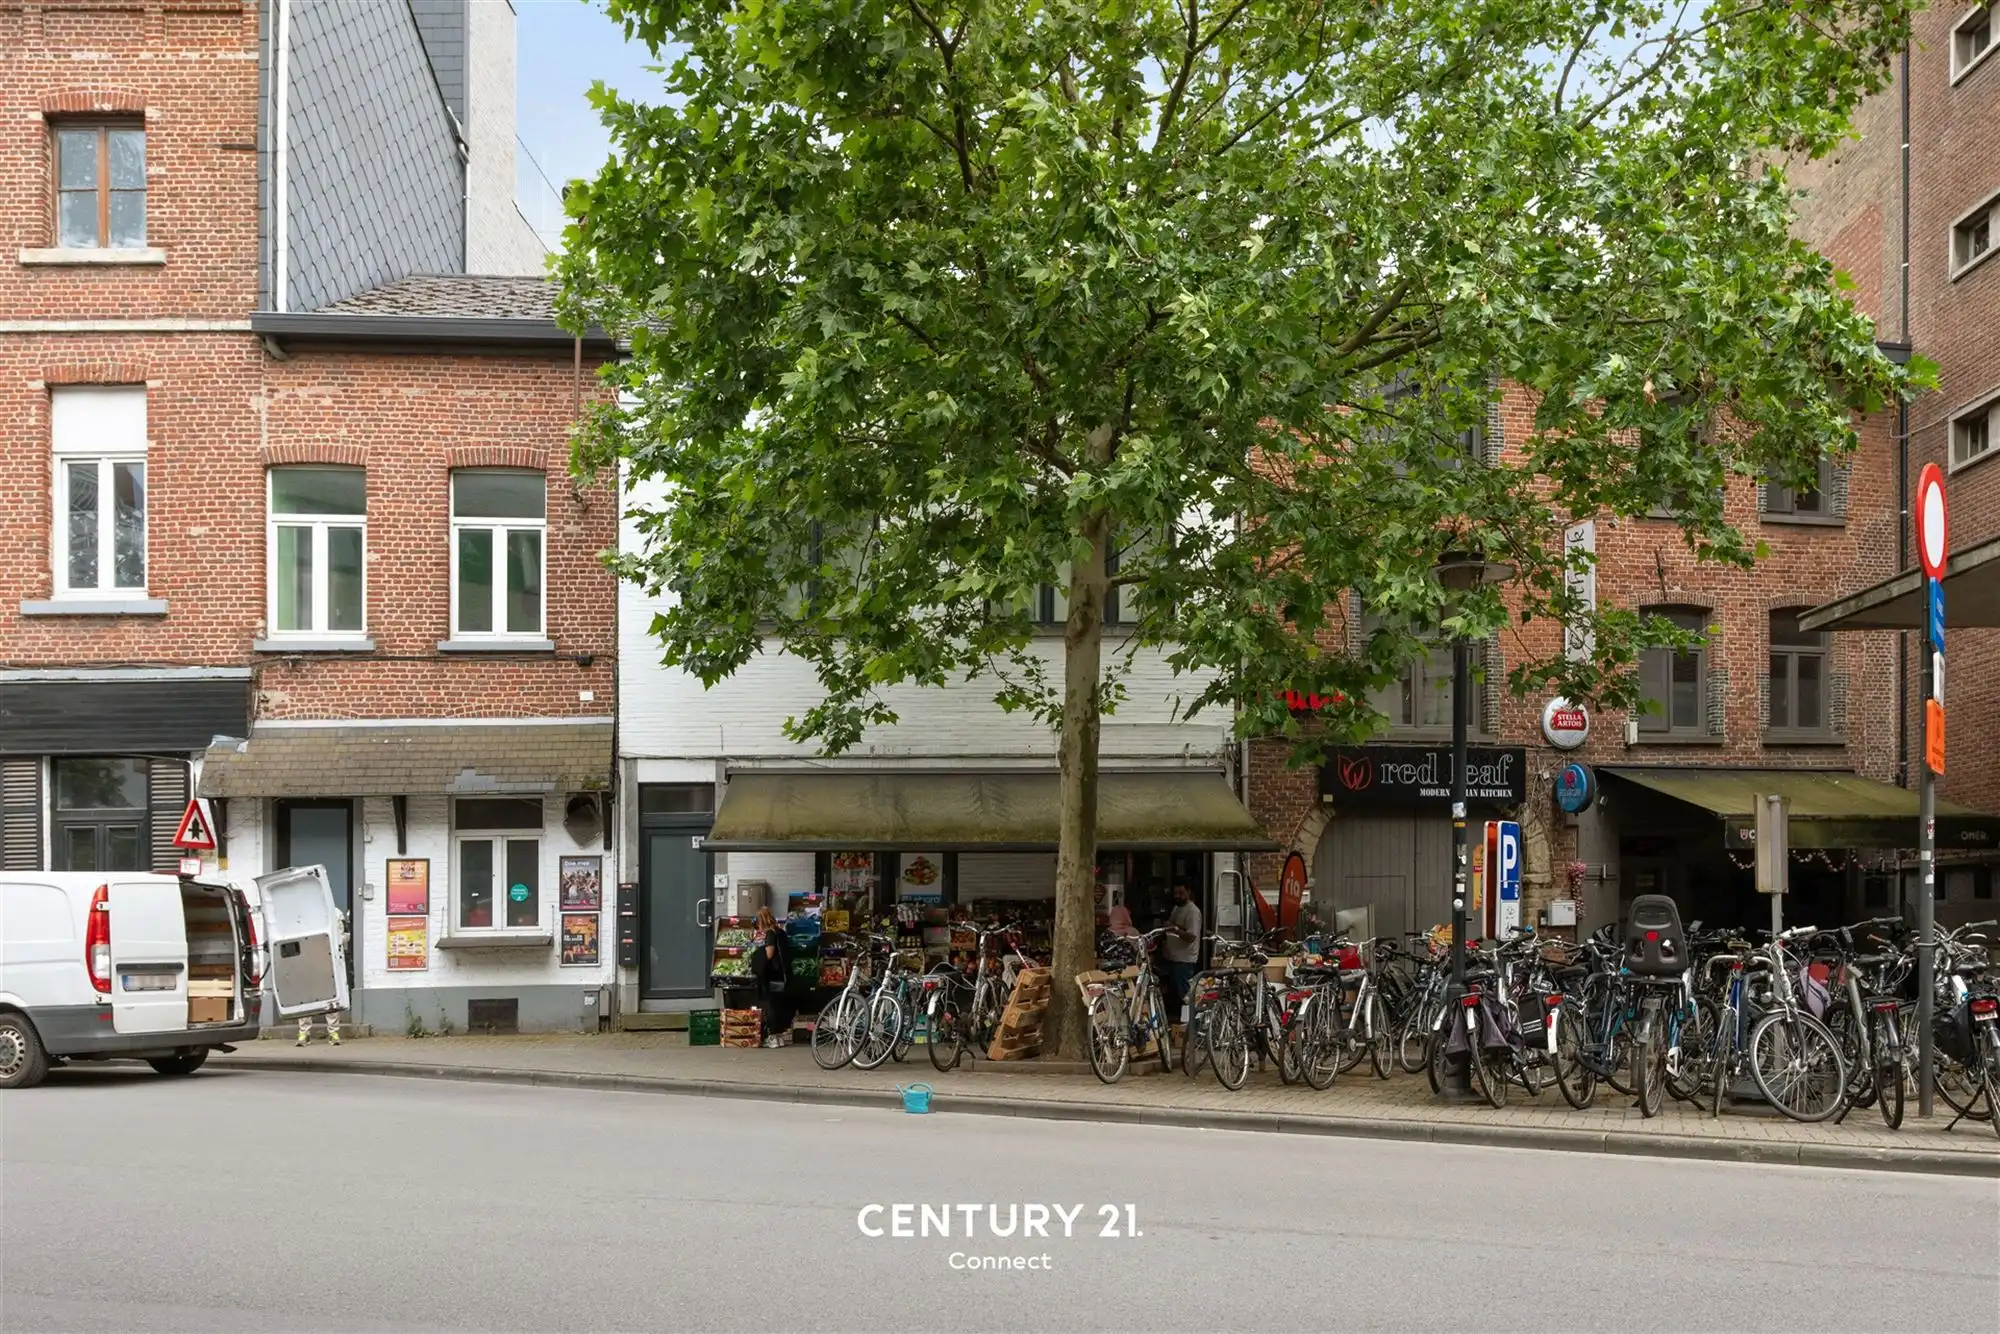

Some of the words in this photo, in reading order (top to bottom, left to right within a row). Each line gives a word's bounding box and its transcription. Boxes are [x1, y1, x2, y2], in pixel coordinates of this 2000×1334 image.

[1557, 713, 1582, 721] STELLA
[1380, 752, 1439, 785] red
[1420, 788, 1451, 797] MODERN
[1480, 788, 1512, 798] KITCHEN
[1502, 834, 1517, 888] P
[1284, 870, 1300, 898] ria
